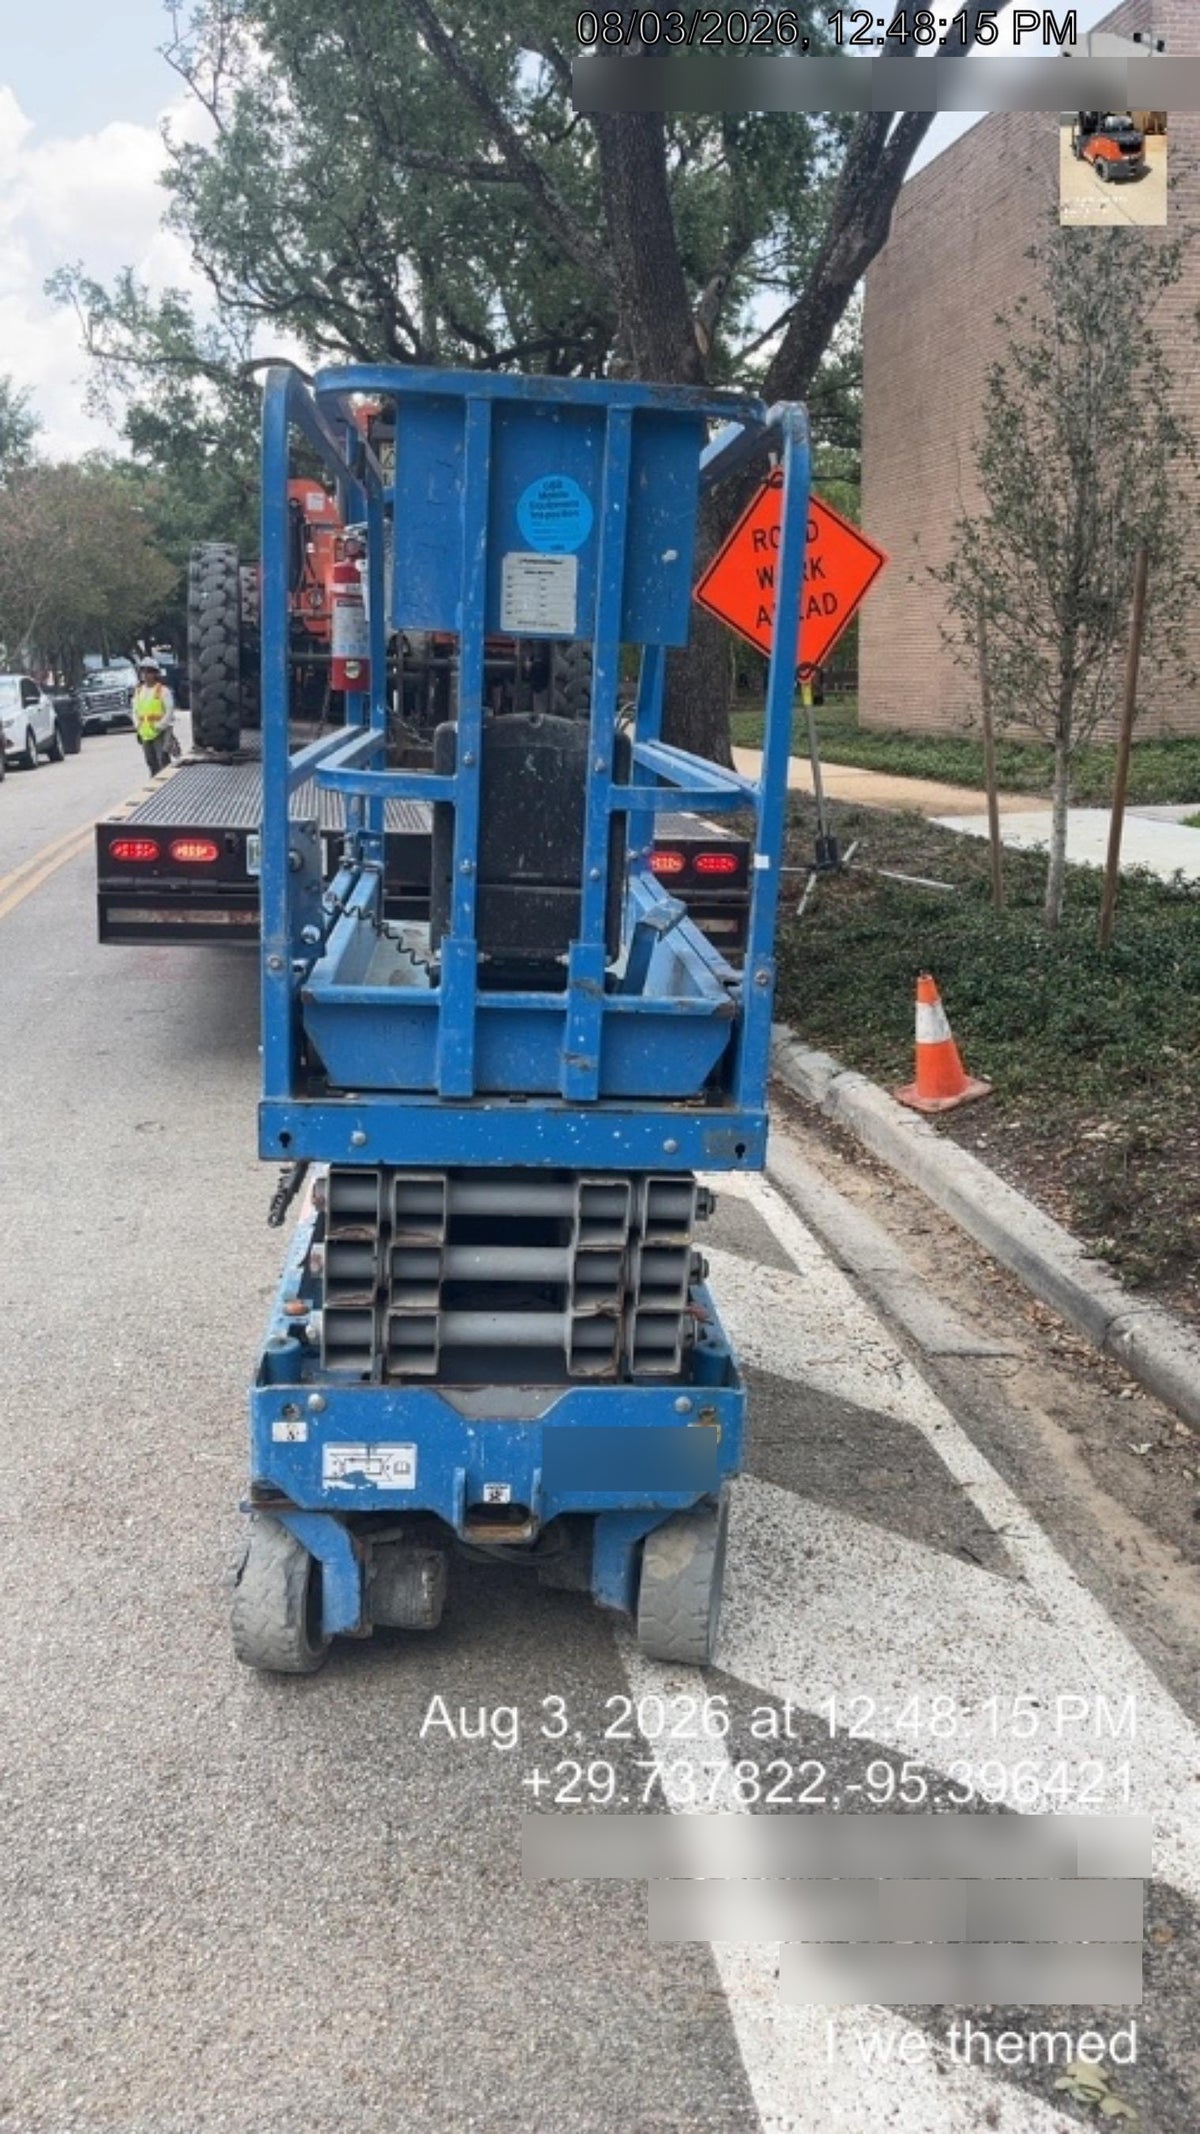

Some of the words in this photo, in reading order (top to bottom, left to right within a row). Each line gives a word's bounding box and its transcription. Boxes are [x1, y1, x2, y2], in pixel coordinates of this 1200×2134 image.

[752, 519, 819, 553] ROD
[756, 556, 826, 590] WK
[756, 592, 838, 629] AAD
